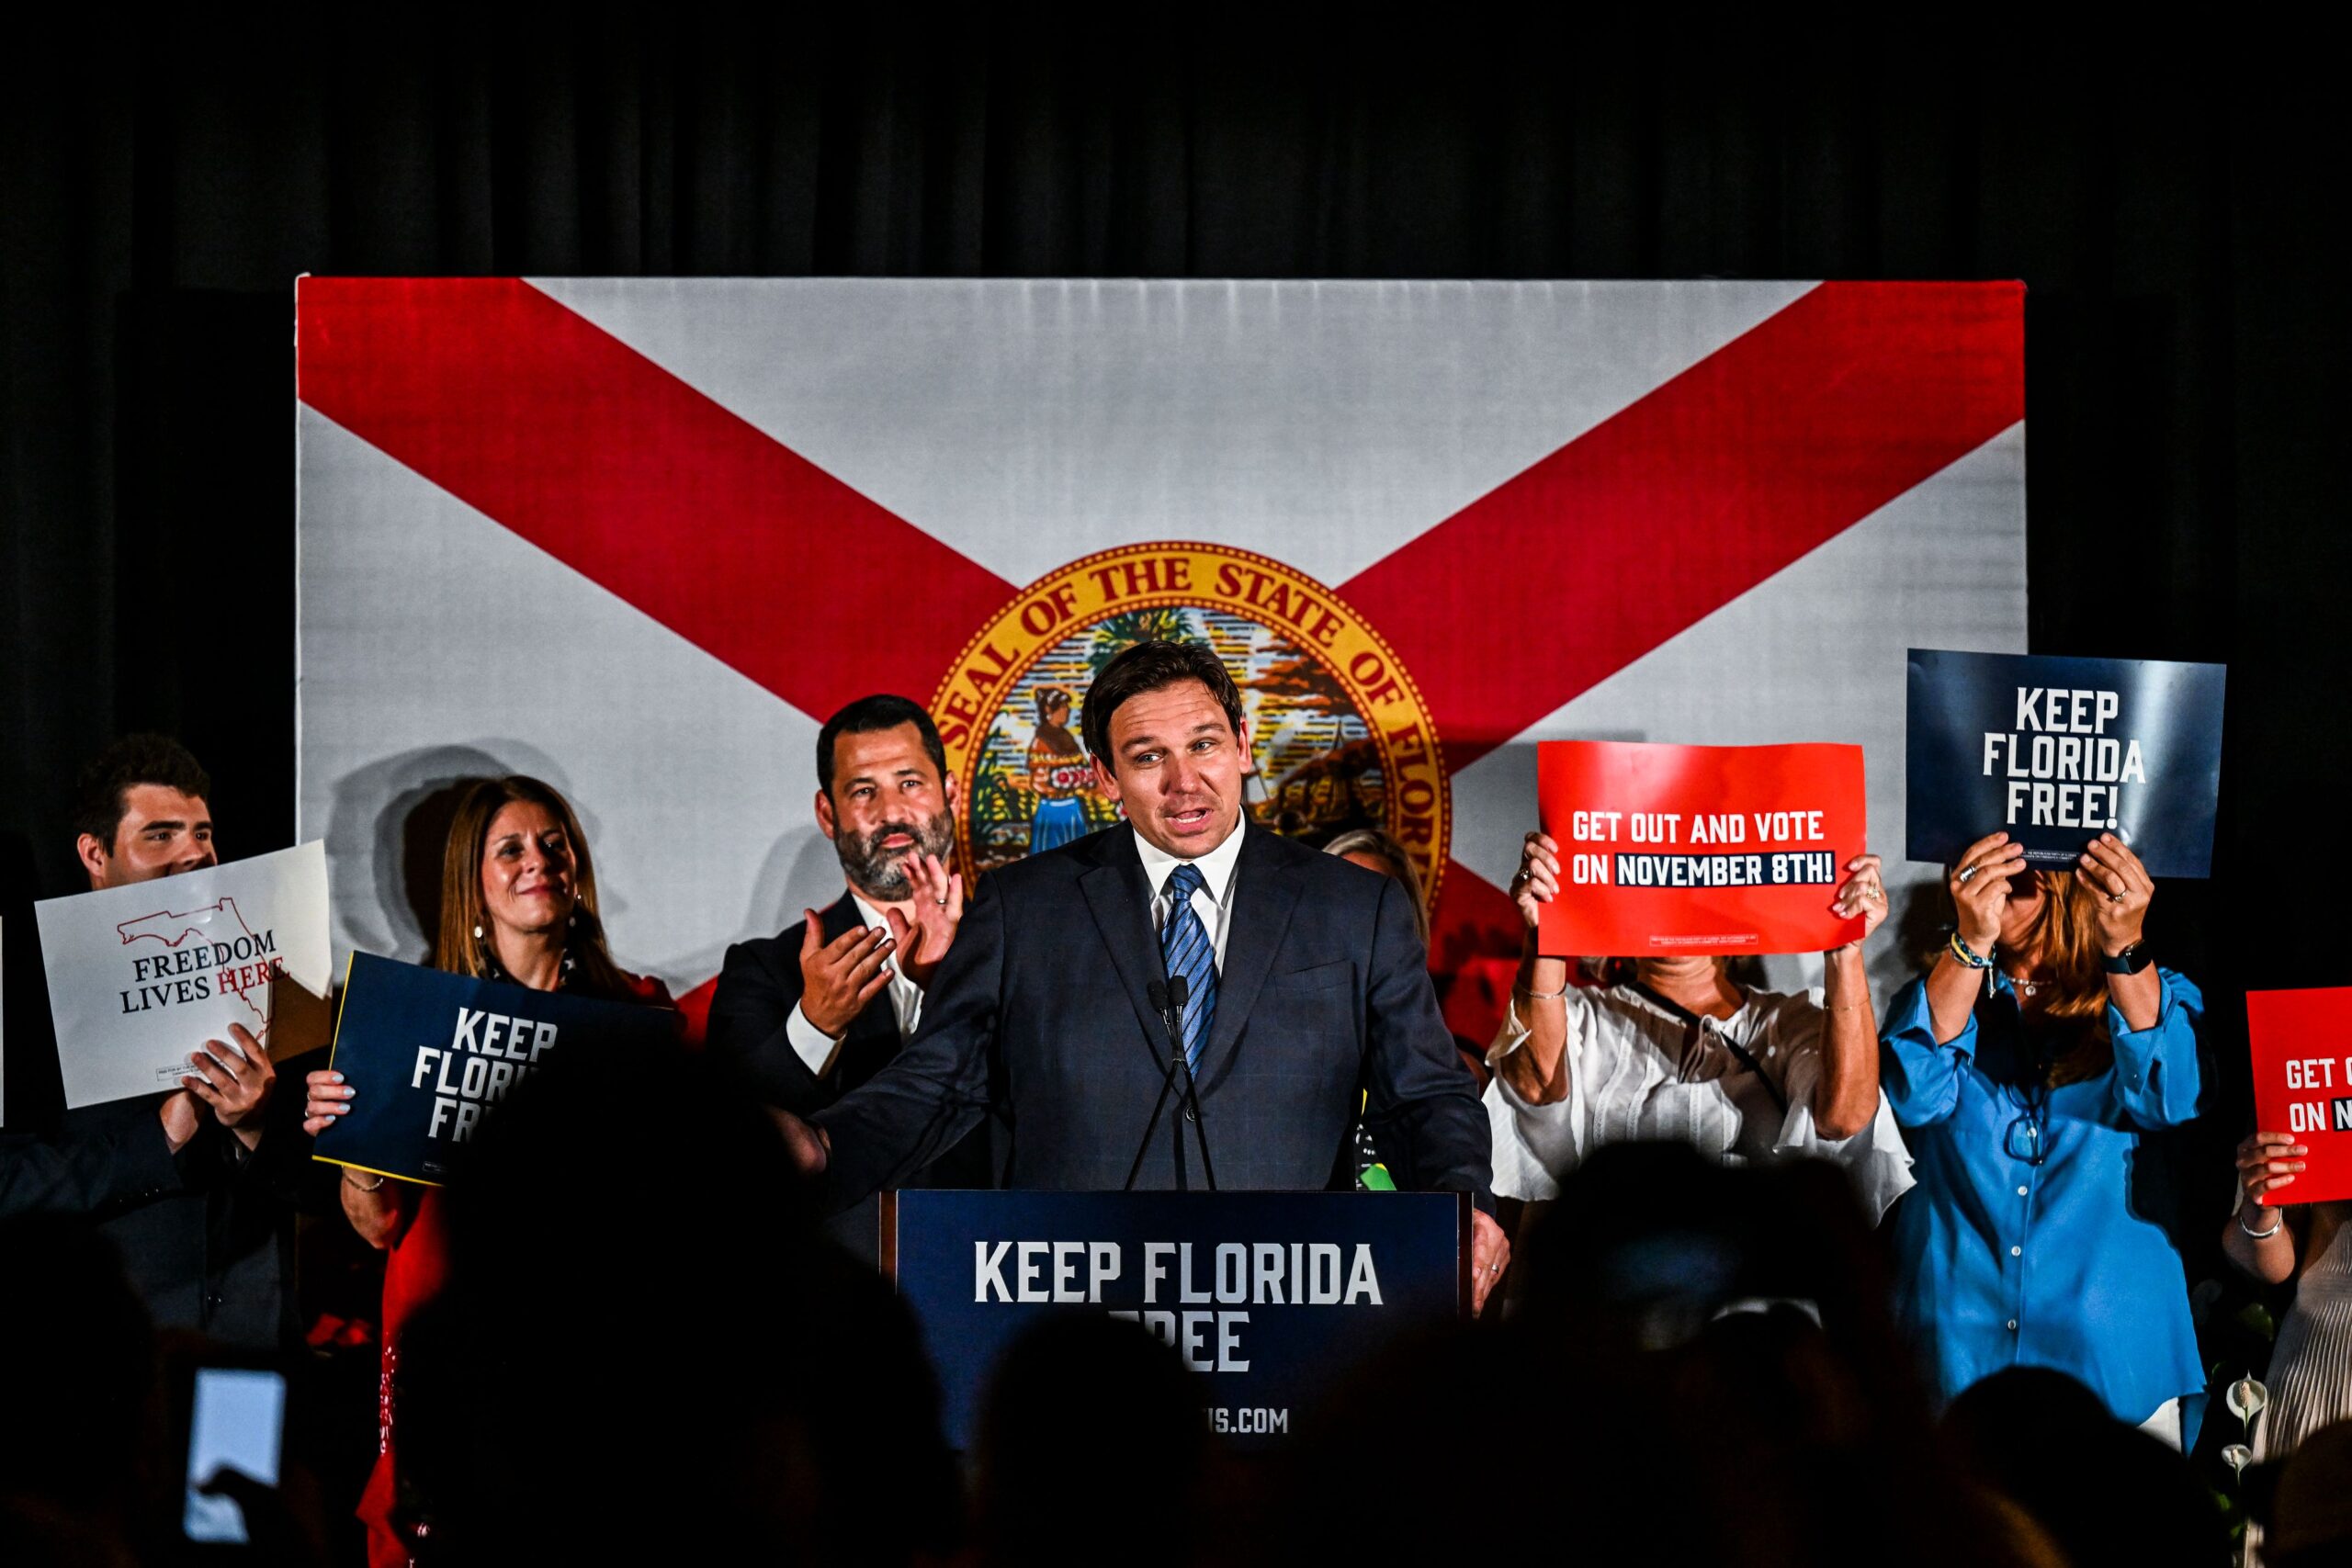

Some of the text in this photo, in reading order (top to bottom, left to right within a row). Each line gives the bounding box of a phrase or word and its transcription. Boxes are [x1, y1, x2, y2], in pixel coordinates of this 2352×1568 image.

[936, 643, 1021, 750] SEAL
[1021, 582, 1077, 637] OF
[1089, 557, 1192, 603] THE
[1214, 563, 1345, 649] STATE
[1350, 651, 1405, 706] OF
[2016, 687, 2119, 734] KEEP
[1983, 732, 2146, 784] FLORIDA
[1573, 810, 1825, 844] GET OUT AND VOTE
[2007, 782, 2119, 829] FREE!
[1573, 852, 1834, 886] ON NOVEMBER 8TH!
[132, 930, 277, 983] FREEDOM
[119, 956, 290, 1014] LIVES HERE
[451, 1007, 559, 1063] KEEP
[2286, 1057, 2335, 1089] GET
[427, 1096, 497, 1145] FR
[2289, 1101, 2326, 1133] ON
[974, 1241, 1384, 1305] KEEP FLORIDA
[1202, 1407, 1289, 1433] IS.COM
